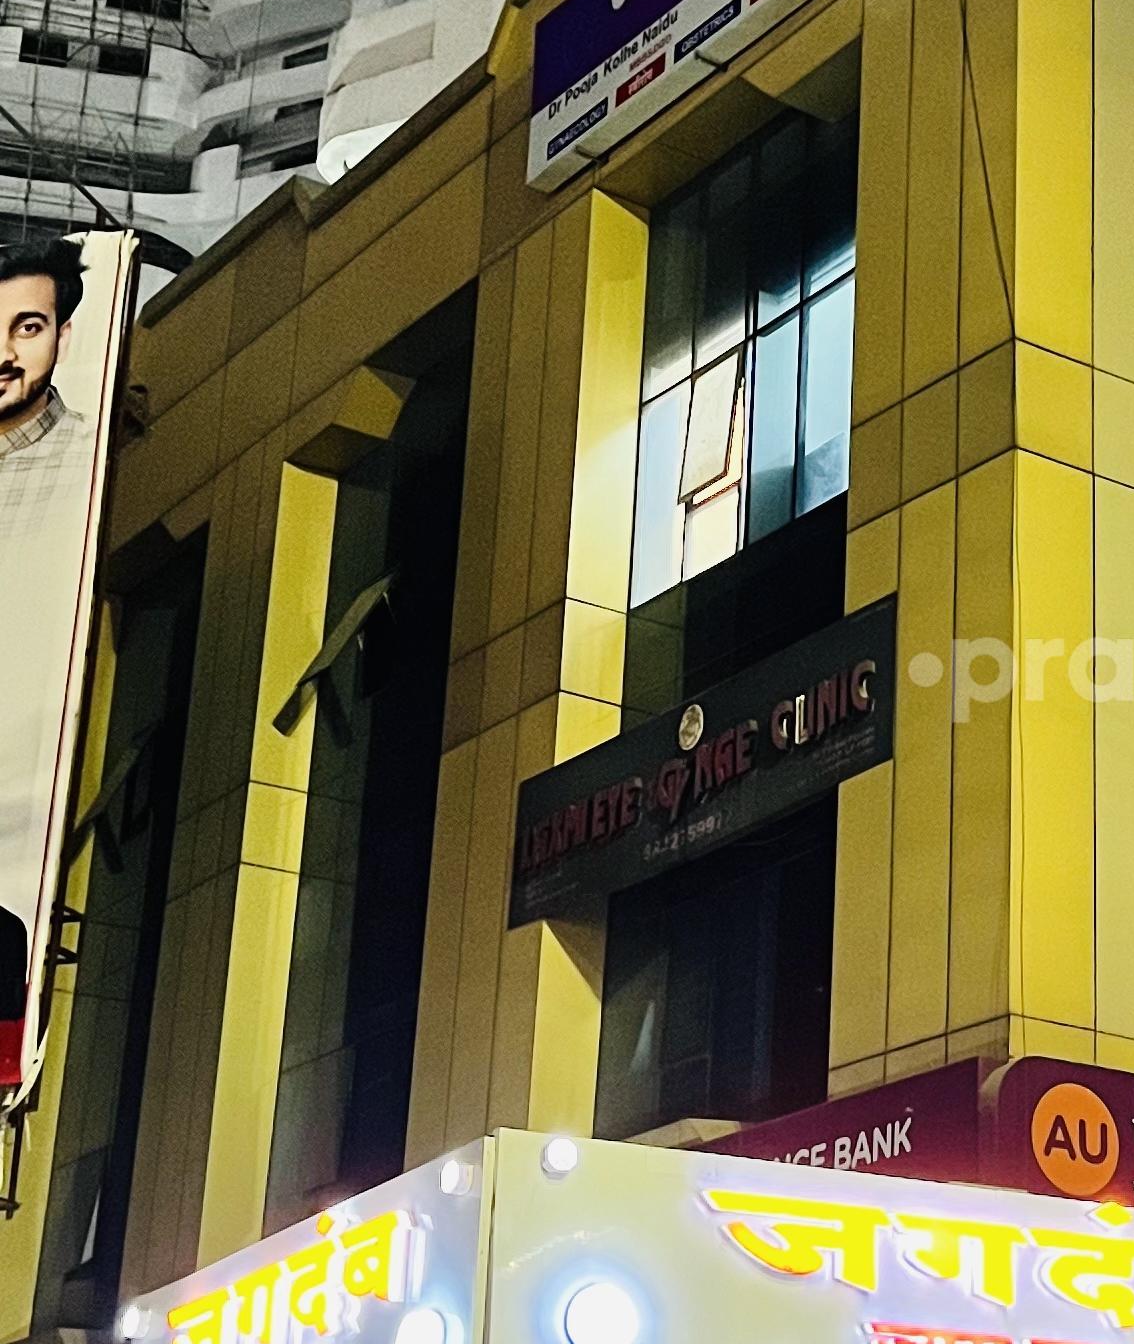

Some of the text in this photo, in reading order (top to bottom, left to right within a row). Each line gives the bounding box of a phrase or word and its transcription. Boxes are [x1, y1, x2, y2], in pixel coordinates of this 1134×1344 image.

[548, 10, 678, 121] Dr Pooja Kolhe Naidu
[770, 659, 876, 752] CLINIC
[834, 1116, 912, 1170] BANK
[1043, 1114, 1110, 1164] AU
